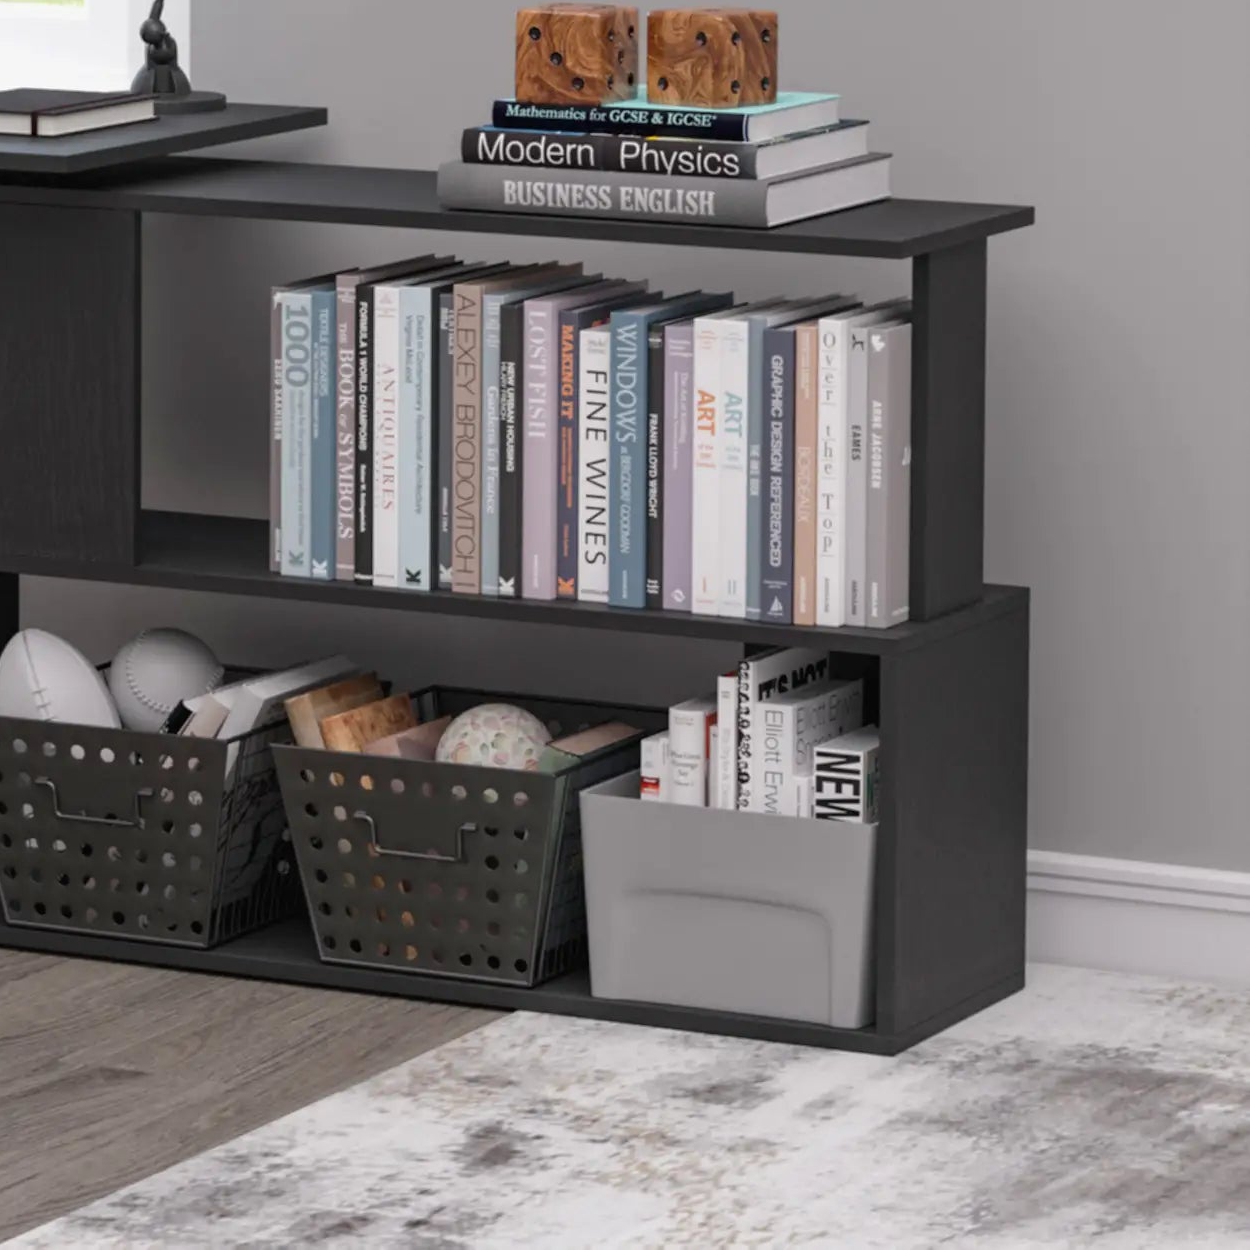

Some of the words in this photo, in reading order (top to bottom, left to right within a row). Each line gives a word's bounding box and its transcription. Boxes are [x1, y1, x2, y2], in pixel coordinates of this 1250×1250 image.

[505, 103, 587, 121] Mathematics
[589, 108, 607, 122] for
[609, 109, 648, 124] GCSE
[651, 112, 664, 124] &
[477, 132, 595, 167] Modern
[619, 140, 740, 176] Physics
[503, 180, 612, 210] BUSINESS
[619, 187, 716, 216] ENGLISH
[285, 305, 309, 388] 1000
[359, 301, 368, 349] FORMULA
[456, 294, 476, 395] ALEXEY
[528, 311, 547, 376] LOST
[339, 350, 355, 410] BOOK
[359, 357, 368, 392] WORLD
[507, 362, 516, 386] NEW
[561, 324, 574, 397] MAKING
[616, 323, 638, 443] WINDOWS
[507, 387, 516, 424] URBAN
[528, 381, 547, 439] FISH
[561, 400, 573, 420] IT
[586, 369, 607, 442] FINE
[771, 355, 784, 418] GRAPHIC
[381, 364, 396, 511] ANTIQUAIRES
[649, 413, 659, 444] FRANK
[697, 390, 717, 437] ART
[724, 392, 743, 438] ART
[871, 400, 883, 430] ARNE
[506, 425, 515, 472] HOUSING
[648, 446, 658, 478] LLOYD
[770, 421, 783, 472] DESIGN
[851, 424, 861, 461] EAMES
[338, 432, 355, 539] SYMBOLS
[455, 404, 476, 574] BRODOVITCH
[648, 479, 658, 519] WRIGHT
[585, 458, 607, 565] WINES
[770, 475, 783, 567] REFERENCED
[764, 710, 783, 763] Elliott
[816, 750, 860, 823] NEW
